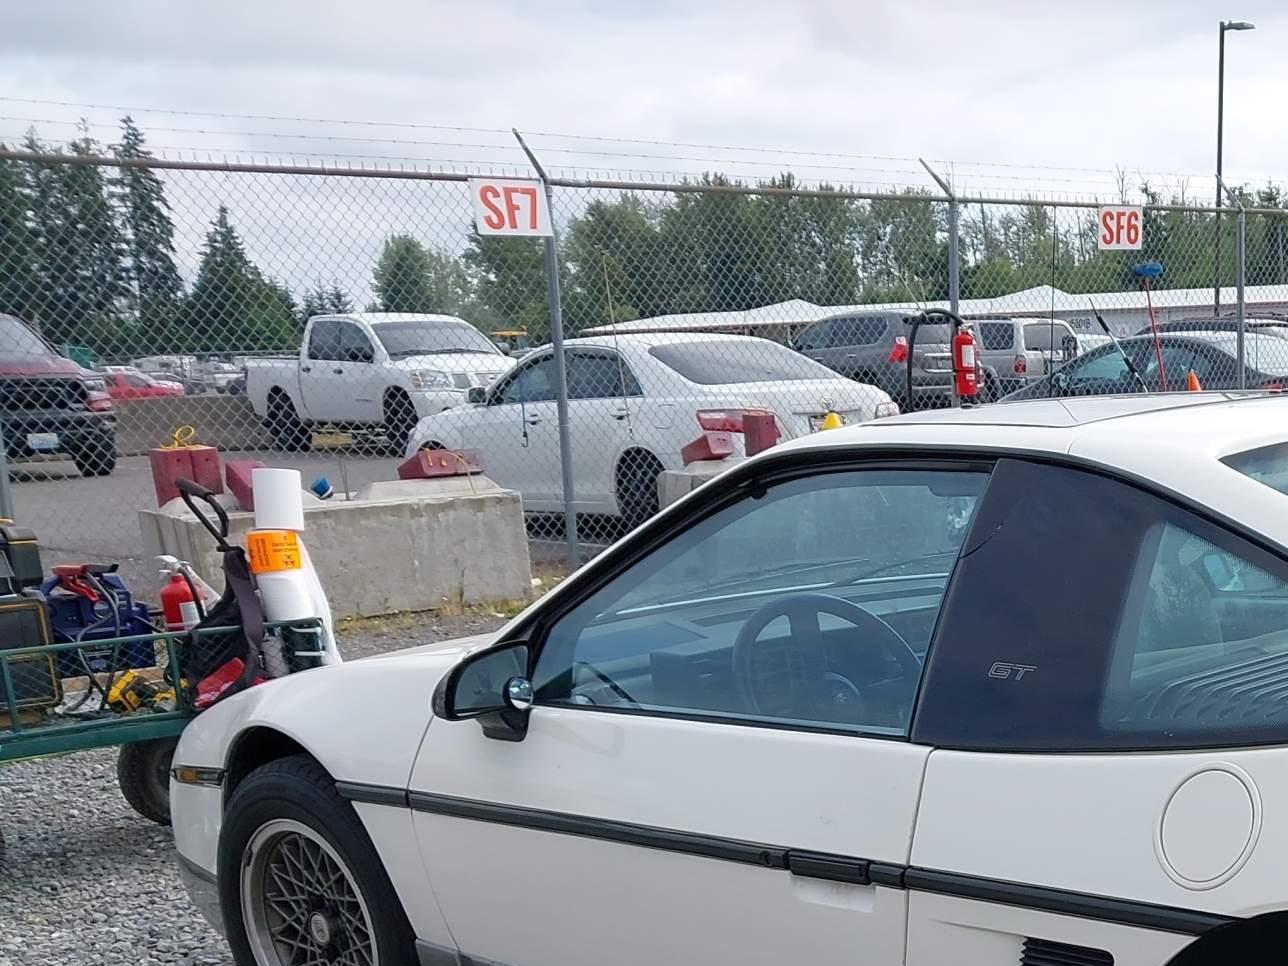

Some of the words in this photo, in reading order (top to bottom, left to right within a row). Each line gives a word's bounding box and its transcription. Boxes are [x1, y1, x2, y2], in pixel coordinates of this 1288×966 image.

[479, 185, 537, 230] SF7
[1102, 211, 1139, 245] SF6
[987, 660, 1038, 681] GT
